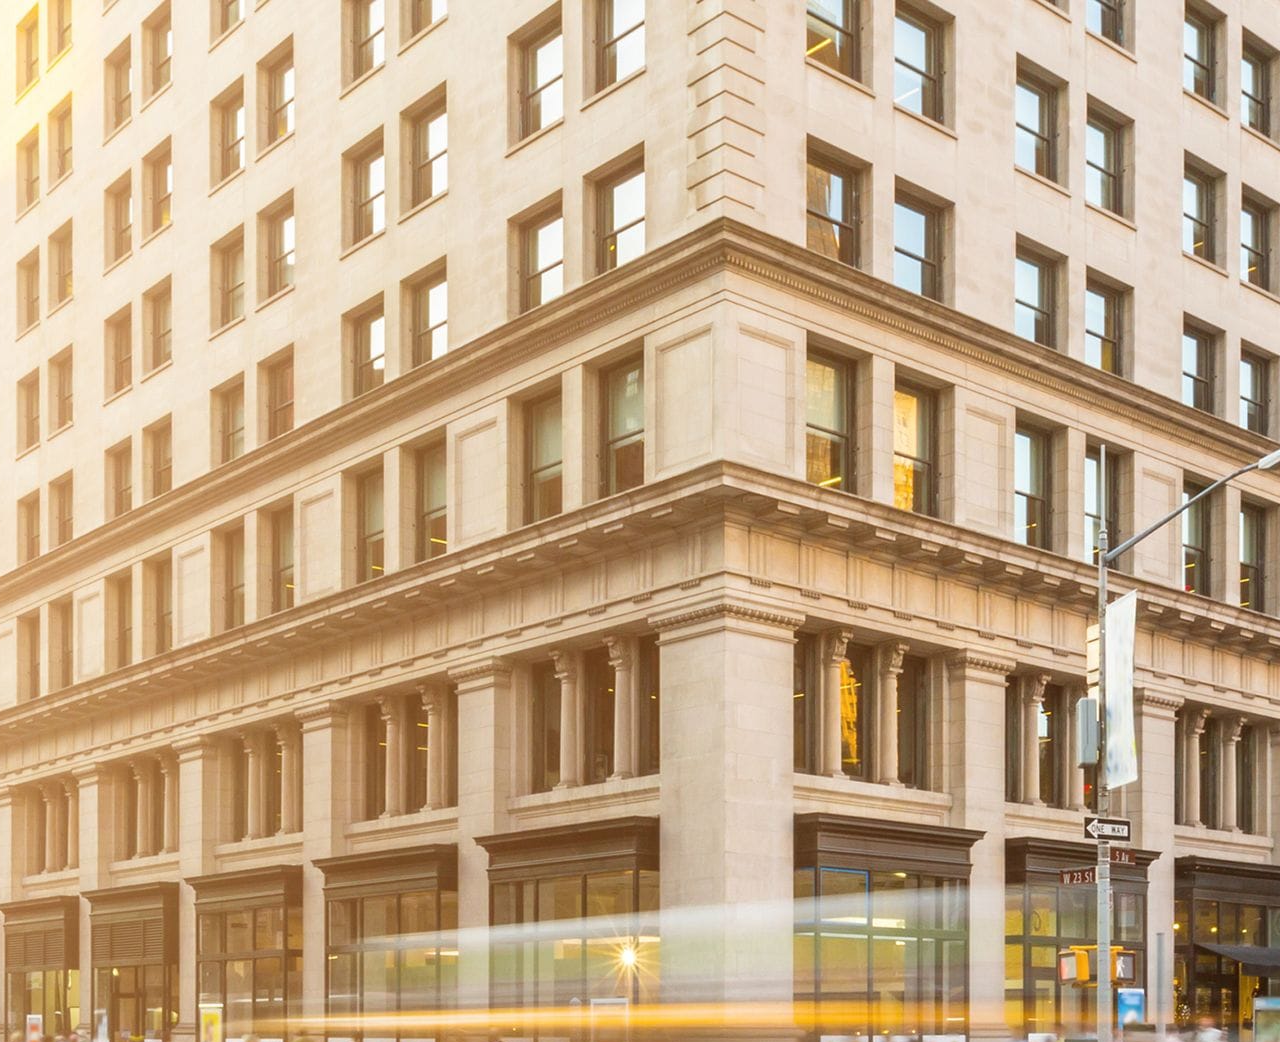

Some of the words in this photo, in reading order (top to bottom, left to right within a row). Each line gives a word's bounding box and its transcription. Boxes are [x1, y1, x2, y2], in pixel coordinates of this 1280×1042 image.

[1091, 824, 1105, 833] ONE
[1111, 826, 1126, 834] WAY
[1062, 873, 1071, 885] W
[1073, 872, 1082, 884] 23
[1084, 871, 1093, 883] St
